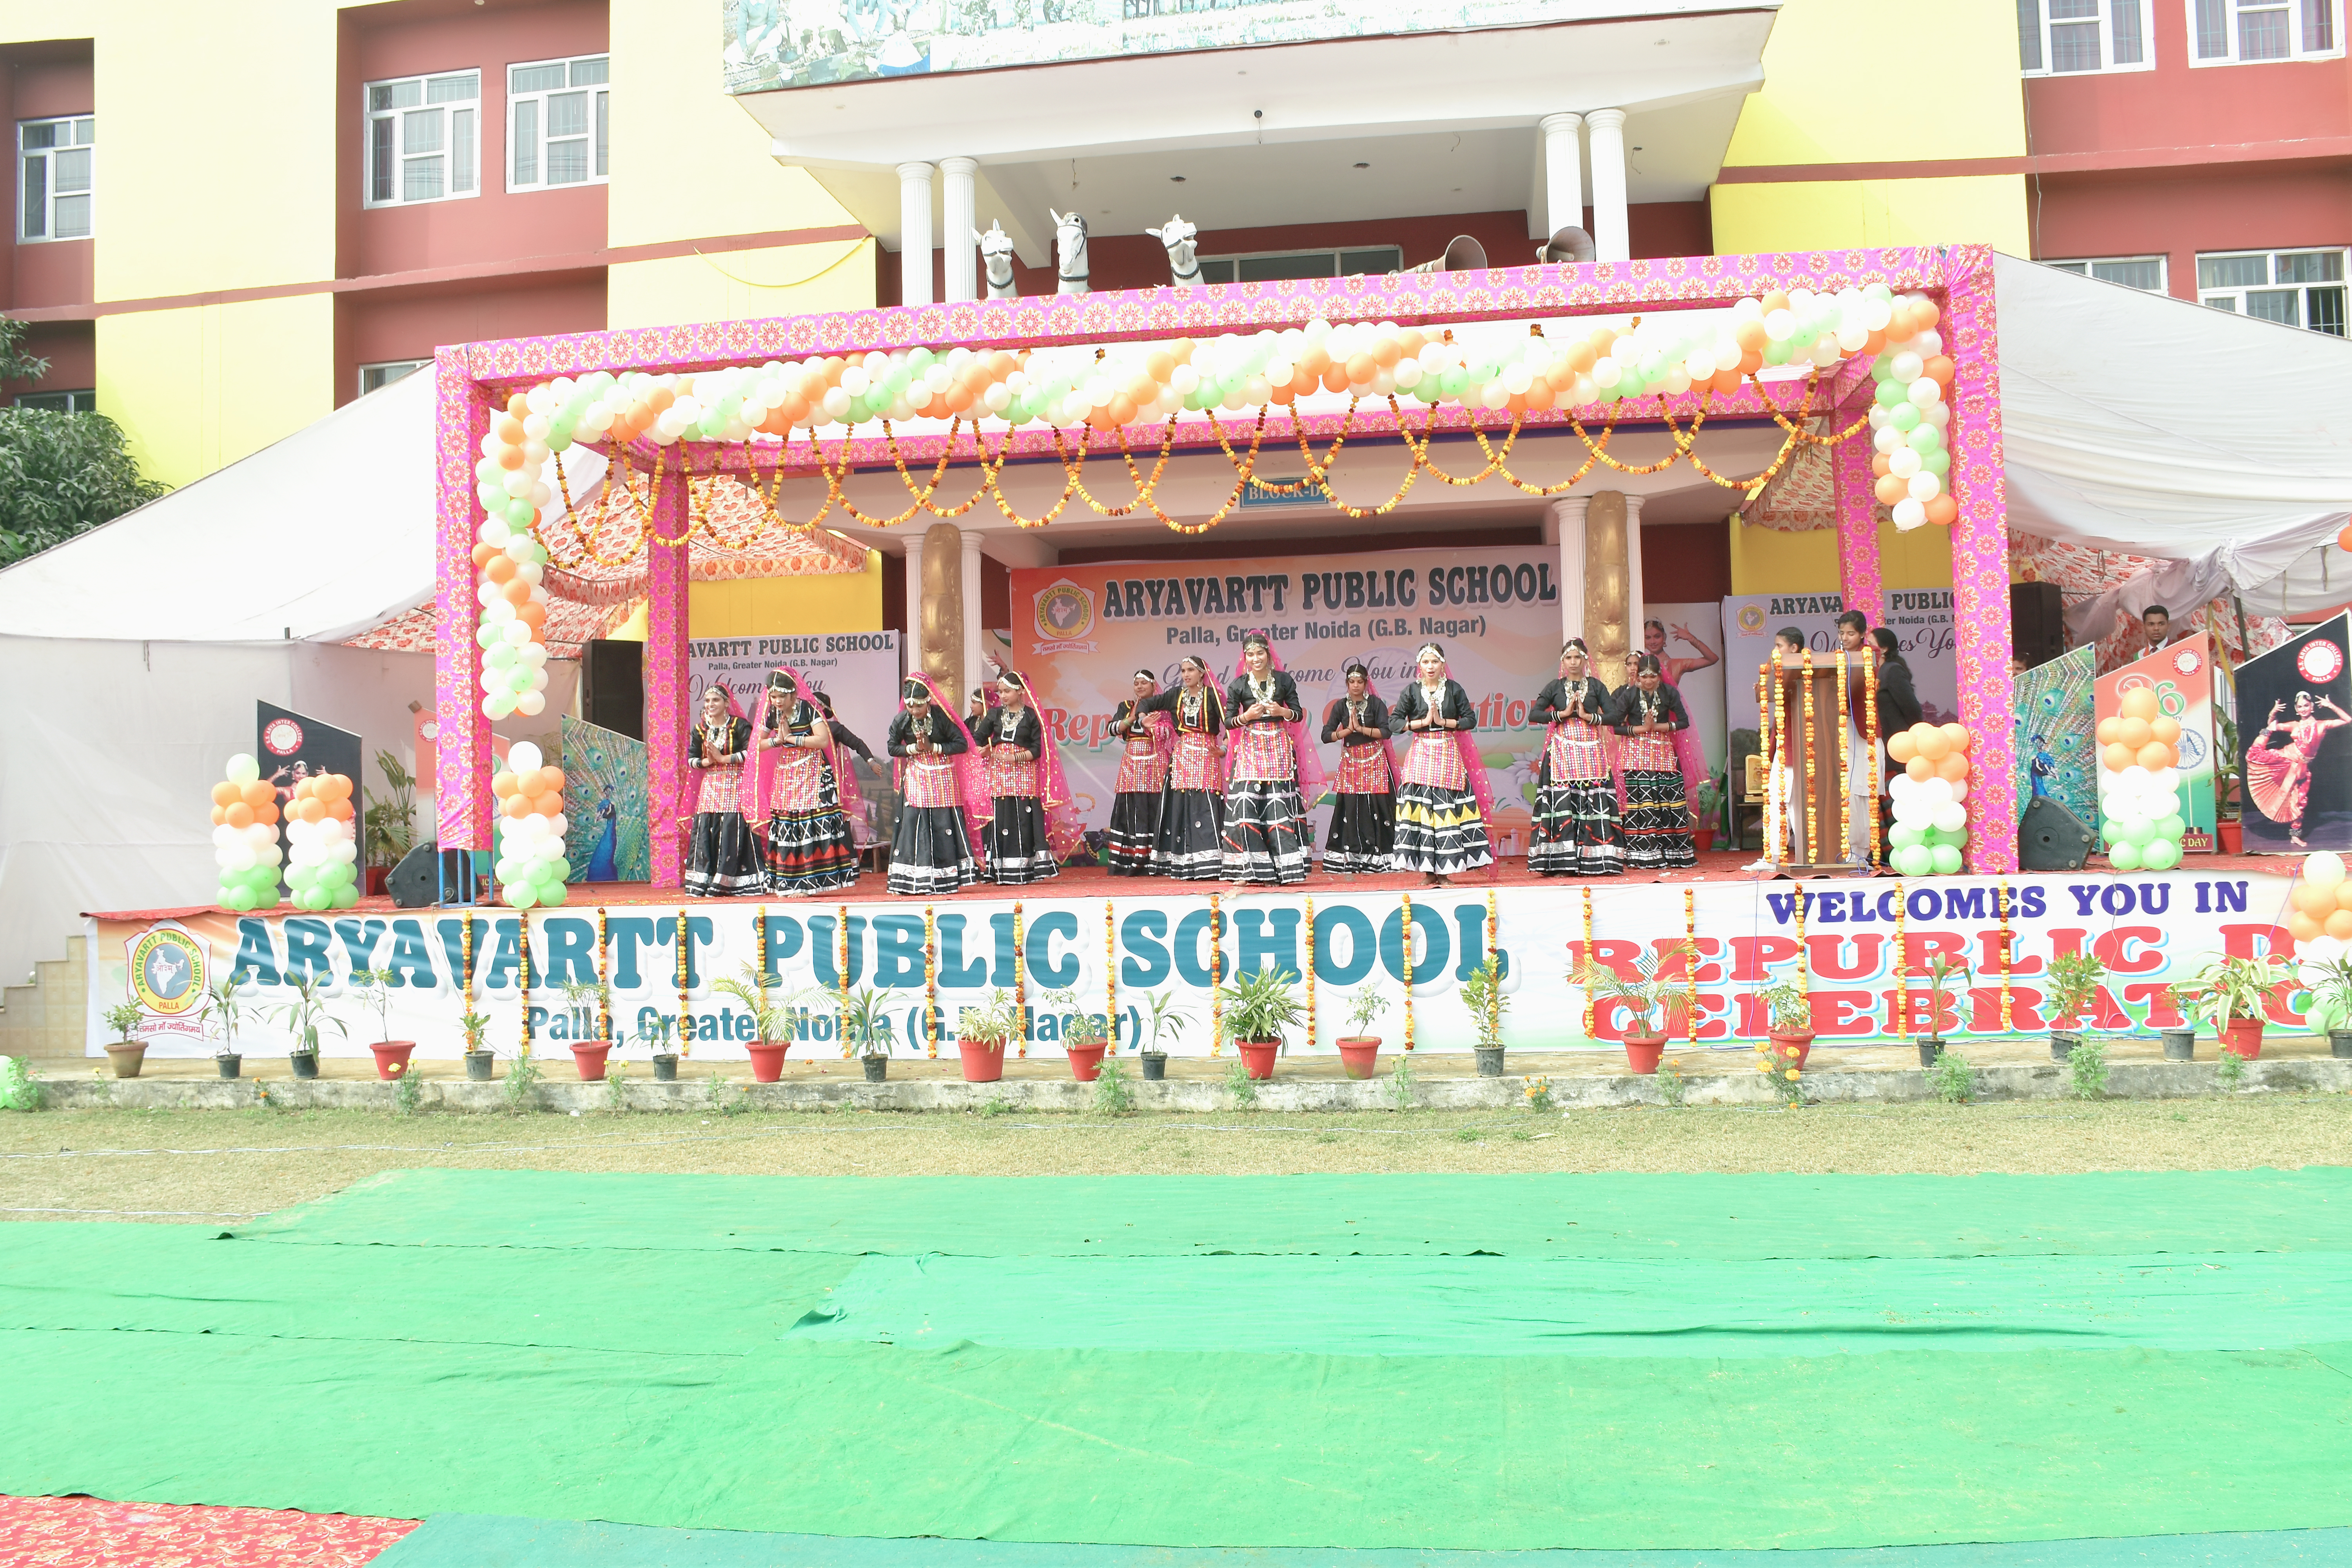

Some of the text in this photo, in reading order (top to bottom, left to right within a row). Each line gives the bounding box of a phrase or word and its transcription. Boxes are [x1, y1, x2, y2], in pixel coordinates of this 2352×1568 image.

[1249, 484, 1320, 500] BLOCK-D
[1040, 588, 1088, 622] ARYAVARTT PUBLIC SCHOOL
[1103, 563, 1557, 617] ARYAVARTT PUBLIC SCHOOL
[1769, 596, 1843, 615] ARYAVA
[1167, 615, 1486, 646] Palla, Grter Noida (G.B. Nagar)
[1899, 616, 1925, 624] Noida
[1928, 615, 1949, 625] (G.B.
[689, 634, 894, 658] AVARTT PUBLIC SCHOOL
[1916, 628, 1956, 659] Yo
[2299, 646, 2310, 660] ARYA
[2327, 643, 2341, 666] COLLEGE
[708, 662, 730, 671] Palla,
[790, 659, 808, 668] (G.B.
[811, 658, 838, 667] Nagar)
[267, 723, 276, 734] ARYA
[291, 722, 302, 742] COLLEGE
[2188, 838, 2209, 847] DAY
[1765, 880, 2249, 924] WELCOMES YOU IN
[135, 932, 201, 986] ARYAVARTT PUBLIC SCHOOL
[230, 904, 1509, 989] ARYAVARTT PUBLIC SCHOOL
[1566, 926, 2165, 985] REPUBLIC
[637, 1006, 762, 1041] Greate
